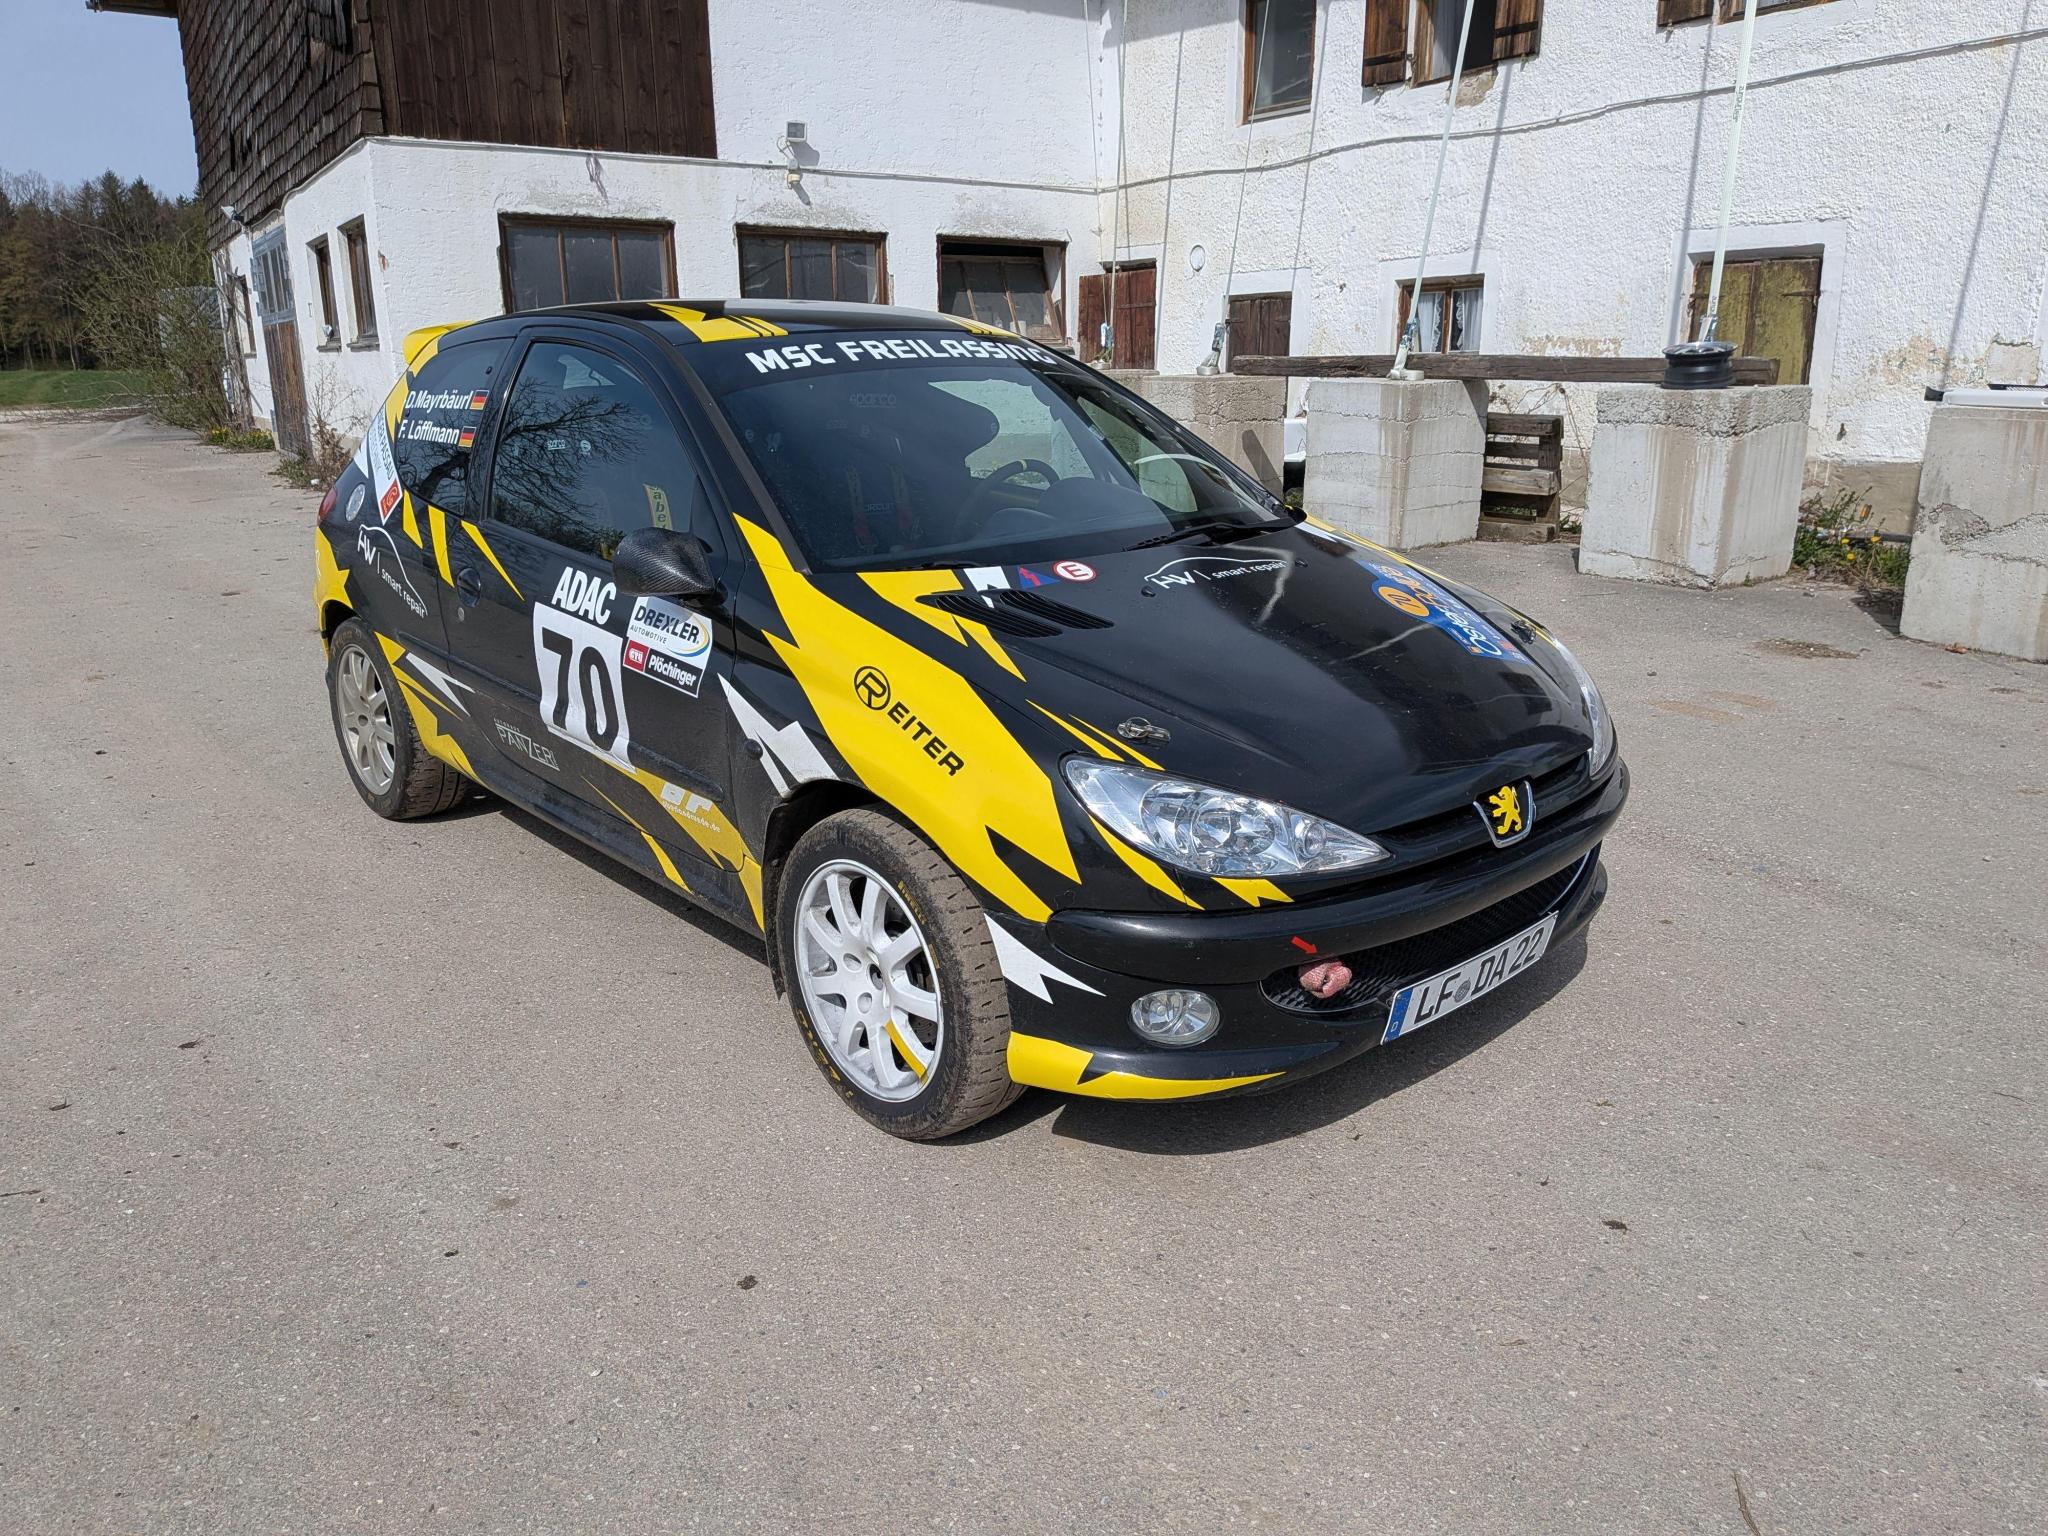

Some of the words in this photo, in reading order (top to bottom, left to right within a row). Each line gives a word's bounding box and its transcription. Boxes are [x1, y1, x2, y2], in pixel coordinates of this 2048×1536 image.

[745, 343, 834, 373] MSC
[836, 339, 1058, 365] FREILASSING
[398, 419, 408, 439] F.
[408, 420, 460, 445] Löfflmann
[1151, 570, 1196, 589] HW
[1212, 566, 1251, 580] smart
[1250, 559, 1289, 574] repair
[381, 568, 402, 597] smart
[403, 590, 425, 618] repair
[551, 566, 617, 625] ADAC
[629, 624, 667, 645] AUTOMOTIVE
[634, 605, 700, 644] DREXLER
[648, 654, 697, 687] Plöchinger
[541, 626, 620, 752] 70
[1413, 971, 1461, 1024] LF
[1473, 954, 1509, 991] DA
[1508, 927, 1545, 975] 22
